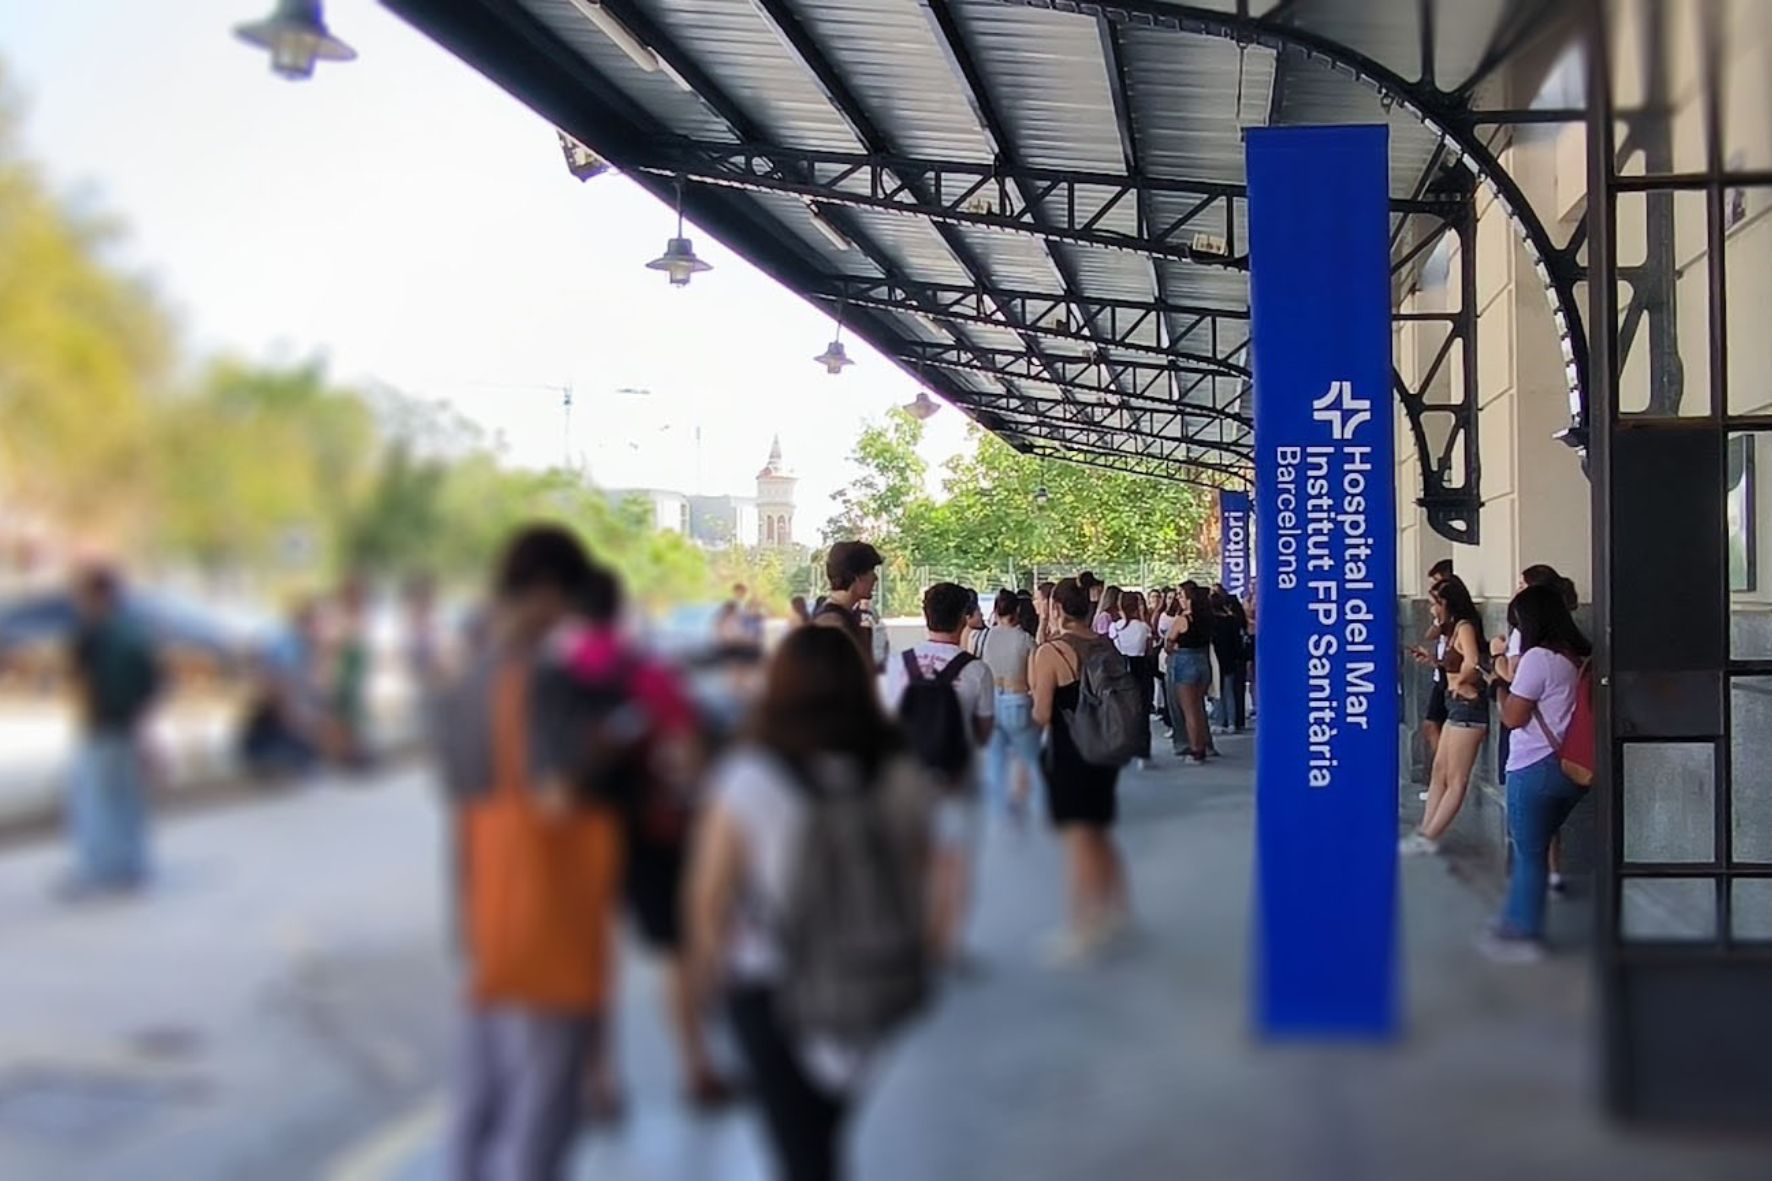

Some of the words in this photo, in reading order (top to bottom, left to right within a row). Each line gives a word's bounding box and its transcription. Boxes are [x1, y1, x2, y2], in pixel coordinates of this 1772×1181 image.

[1276, 446, 1303, 590] Barcelona
[1306, 446, 1337, 571] Institut
[1336, 446, 1374, 589] Hospital
[1307, 580, 1338, 627] FP
[1344, 598, 1375, 653] del
[1308, 634, 1339, 788] Sanitària
[1345, 662, 1376, 730] Mar
